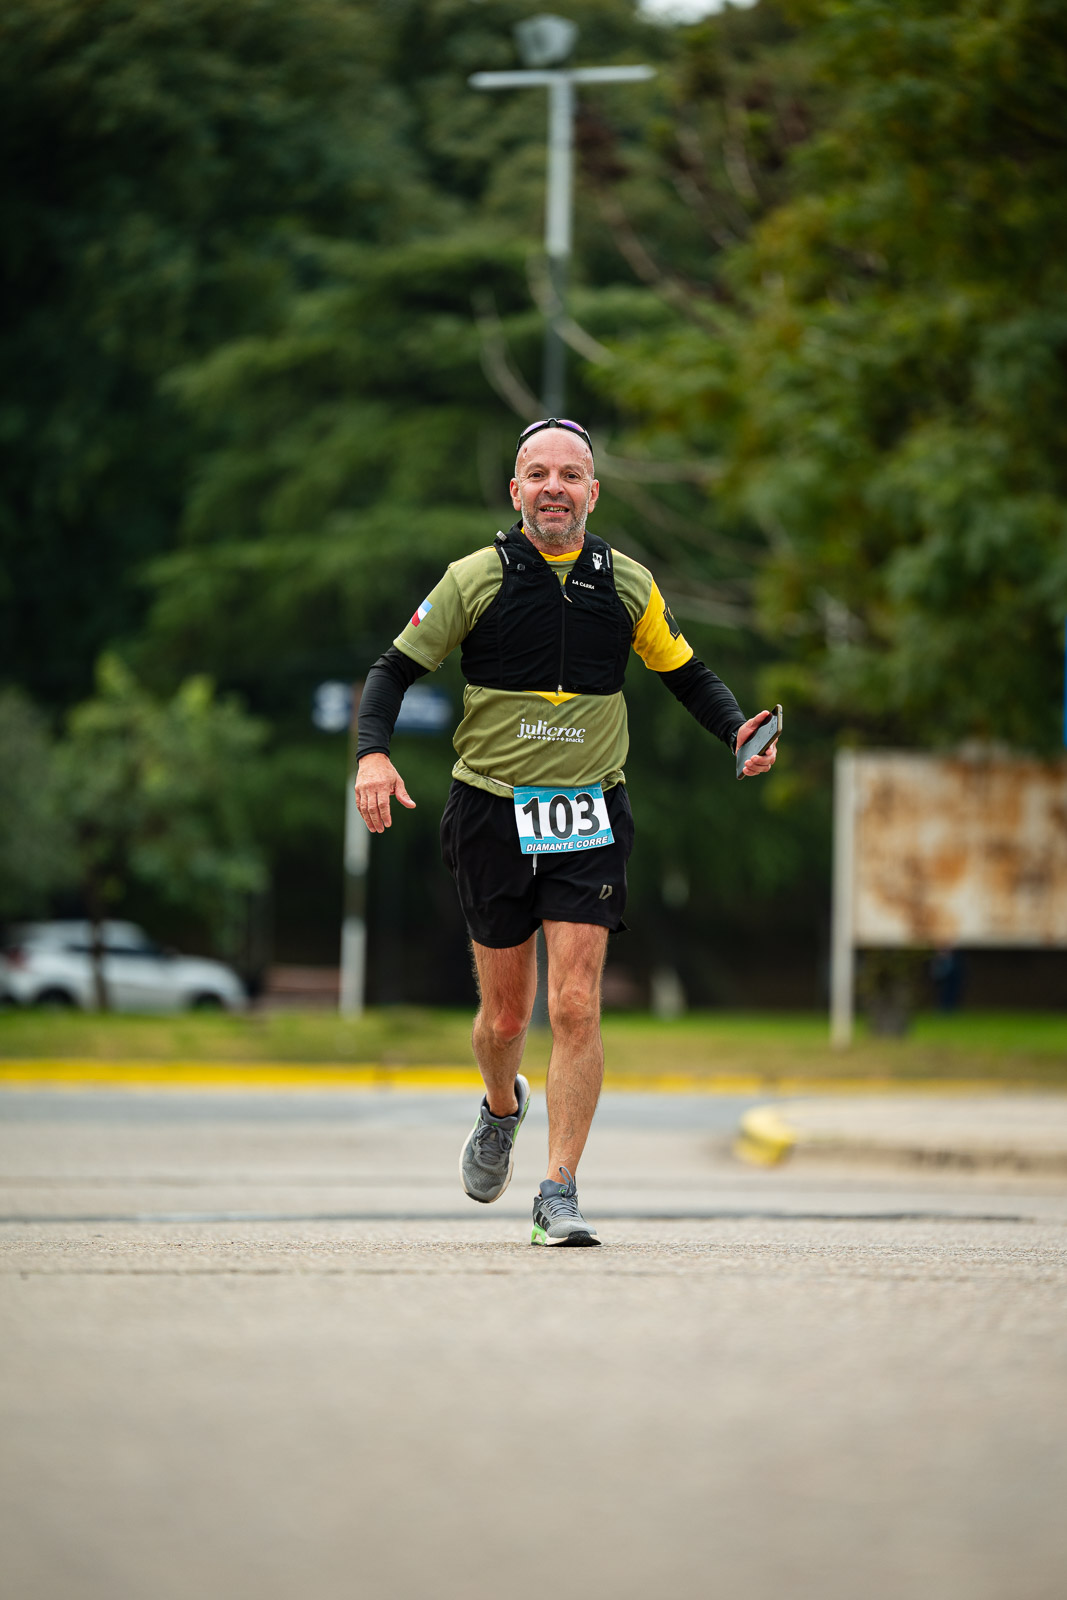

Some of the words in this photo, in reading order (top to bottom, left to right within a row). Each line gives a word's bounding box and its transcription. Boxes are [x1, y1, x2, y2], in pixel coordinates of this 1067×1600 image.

[516, 718, 586, 738] julicroc
[522, 792, 600, 840] 103
[526, 841, 574, 852] DIAMANTE
[576, 836, 608, 848] CORRE
